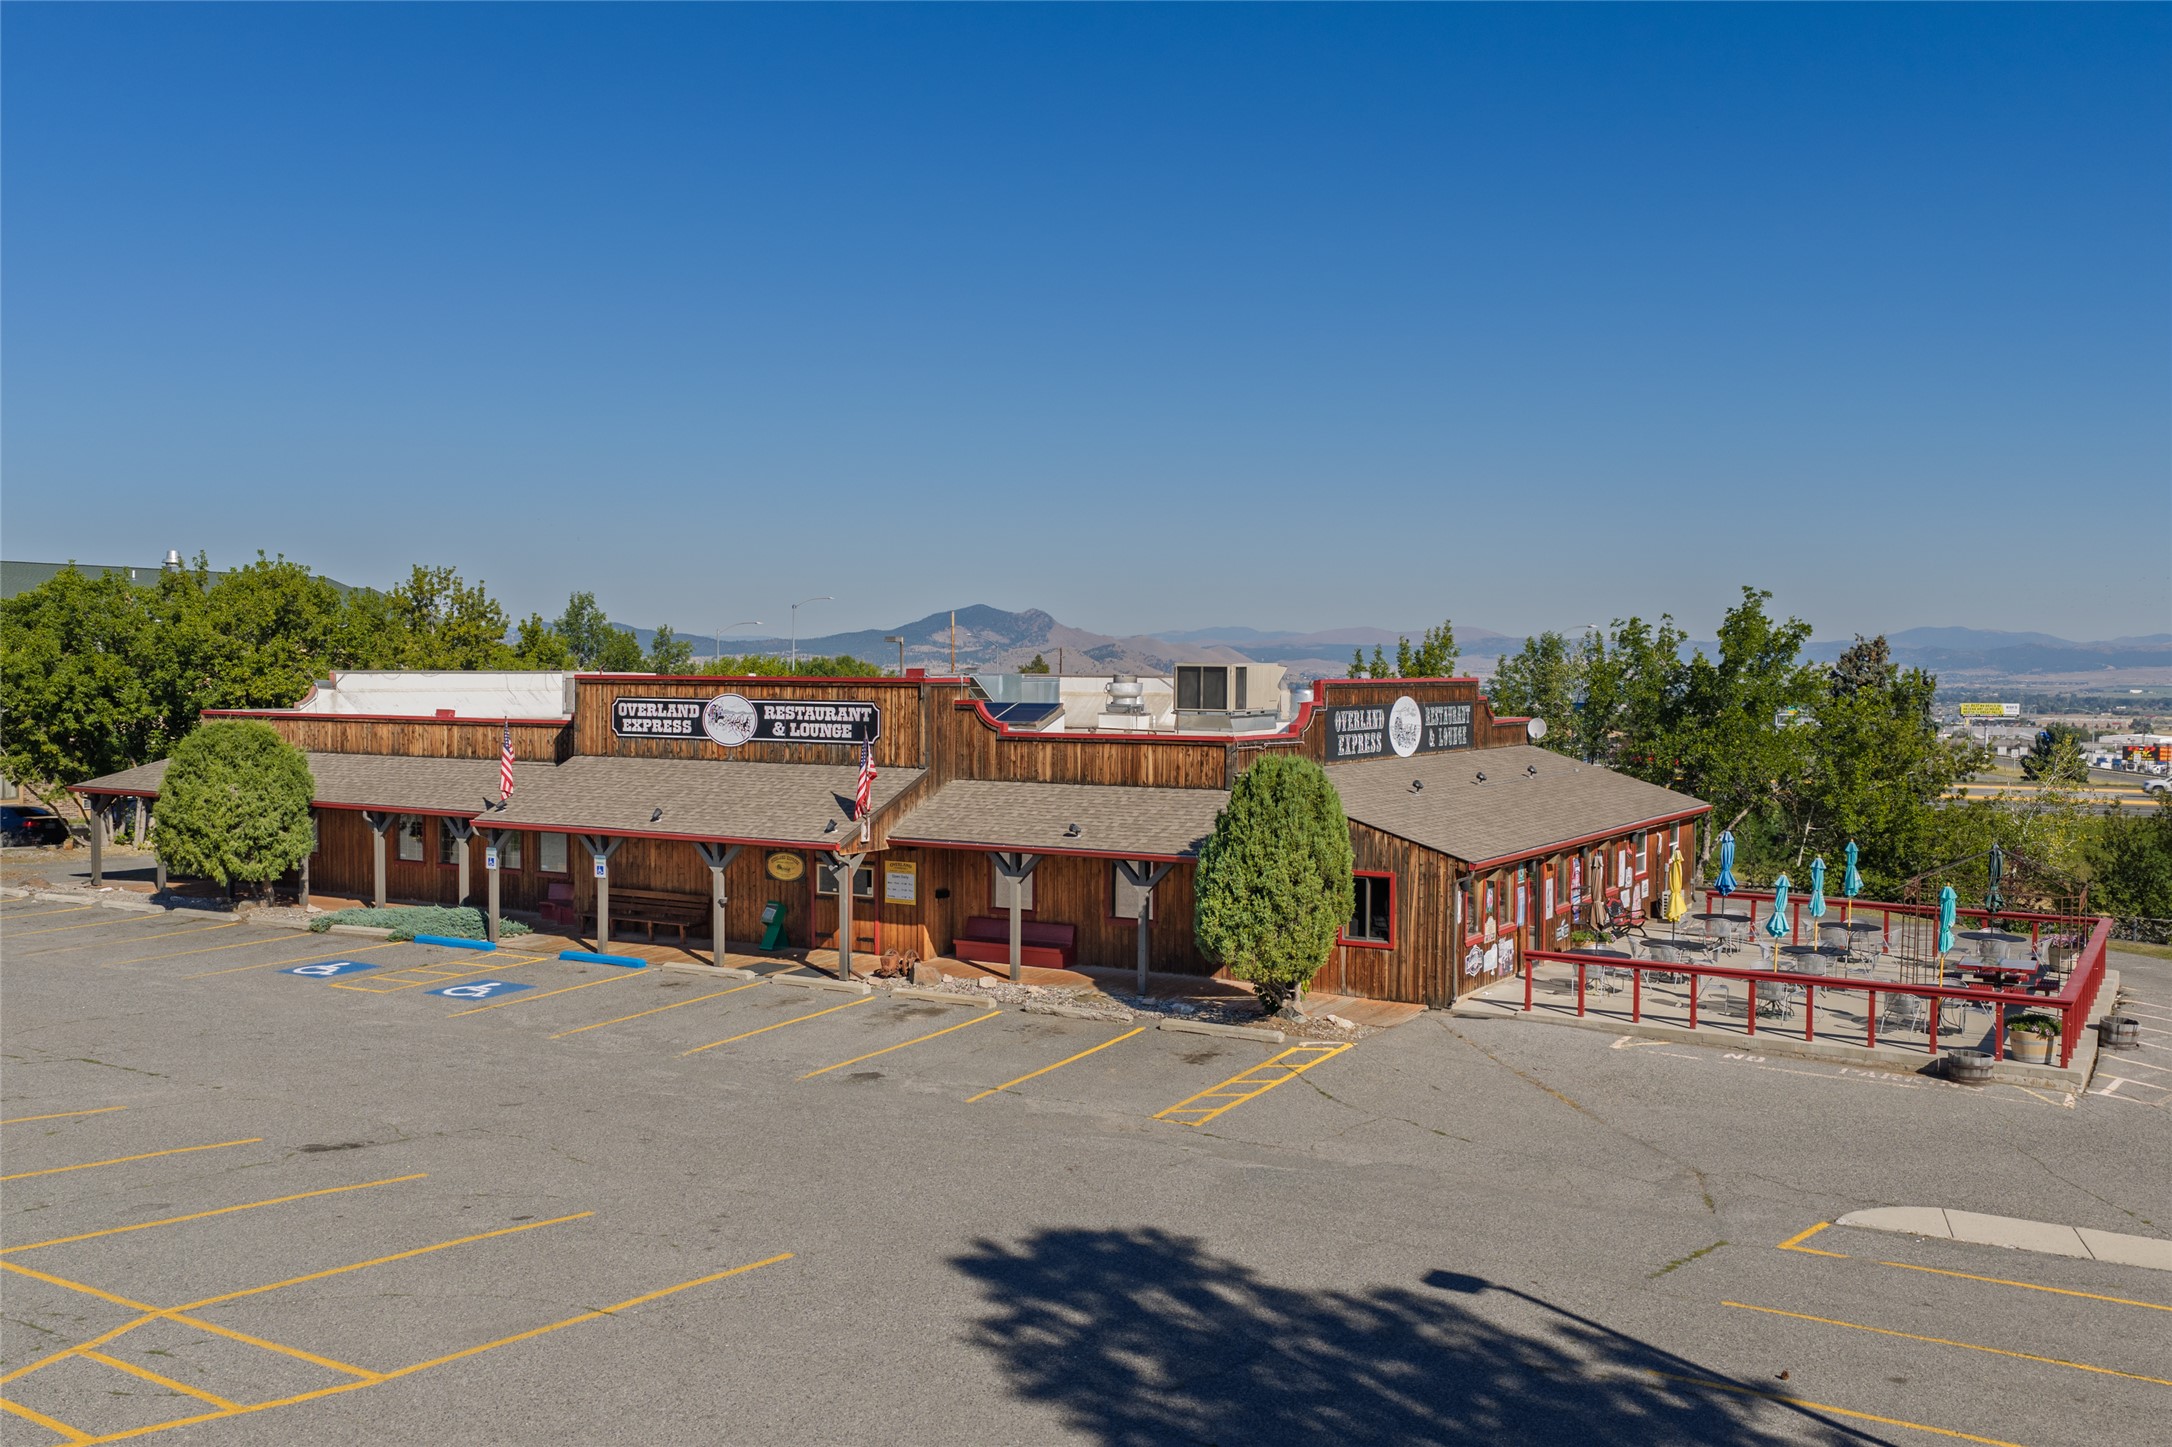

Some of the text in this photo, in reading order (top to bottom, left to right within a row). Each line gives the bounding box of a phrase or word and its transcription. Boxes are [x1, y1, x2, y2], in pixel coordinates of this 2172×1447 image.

[618, 702, 700, 719] OVERLAND
[764, 705, 872, 723] RESTAURANT
[1424, 705, 1471, 727] RESTAURANT
[622, 718, 692, 734] EXPRESS
[1334, 708, 1385, 733] OVERLAND
[772, 721, 853, 739] & LOUNGE
[1428, 725, 1467, 748] & LOUNGE
[1337, 731, 1383, 756] EXPRESS
[1722, 1052, 1766, 1063] NO
